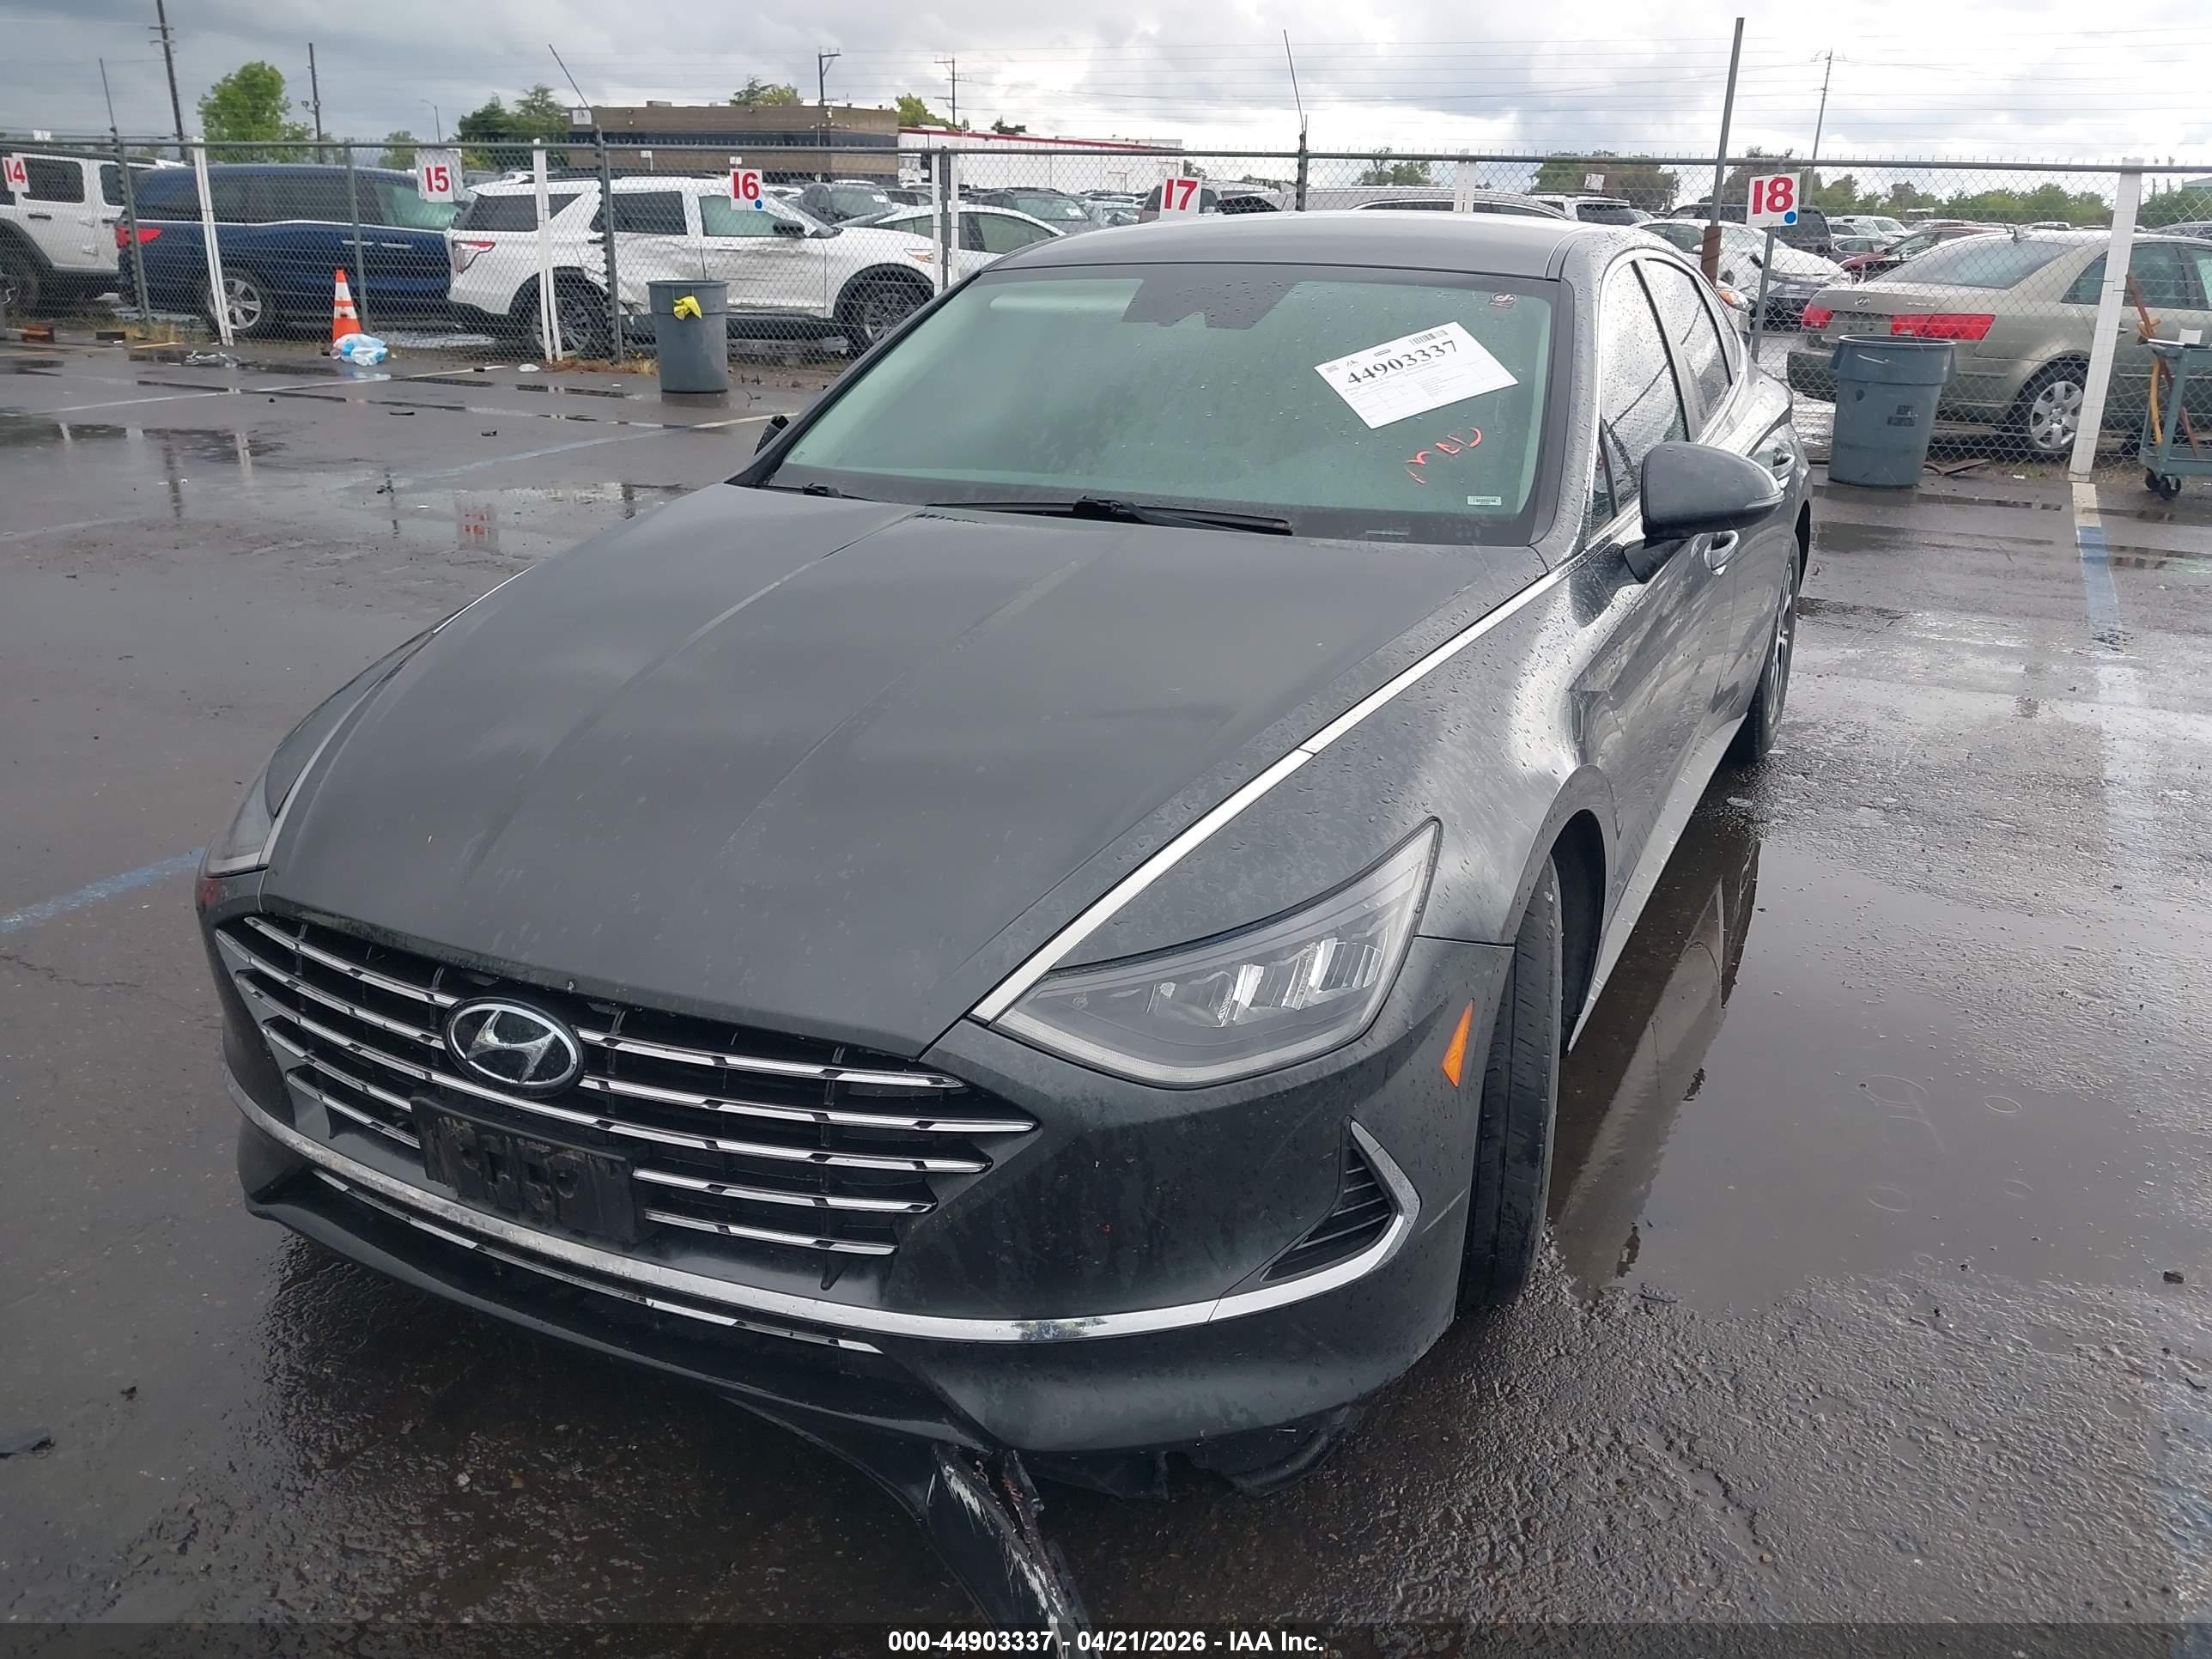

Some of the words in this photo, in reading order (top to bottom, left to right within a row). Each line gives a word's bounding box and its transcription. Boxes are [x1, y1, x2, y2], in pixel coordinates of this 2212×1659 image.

[5, 161, 26, 183] 14
[425, 167, 449, 192] 15
[732, 172, 760, 200] 16
[1164, 178, 1199, 210] 17
[1752, 177, 1794, 215] 18
[1348, 340, 1457, 383] 44903337
